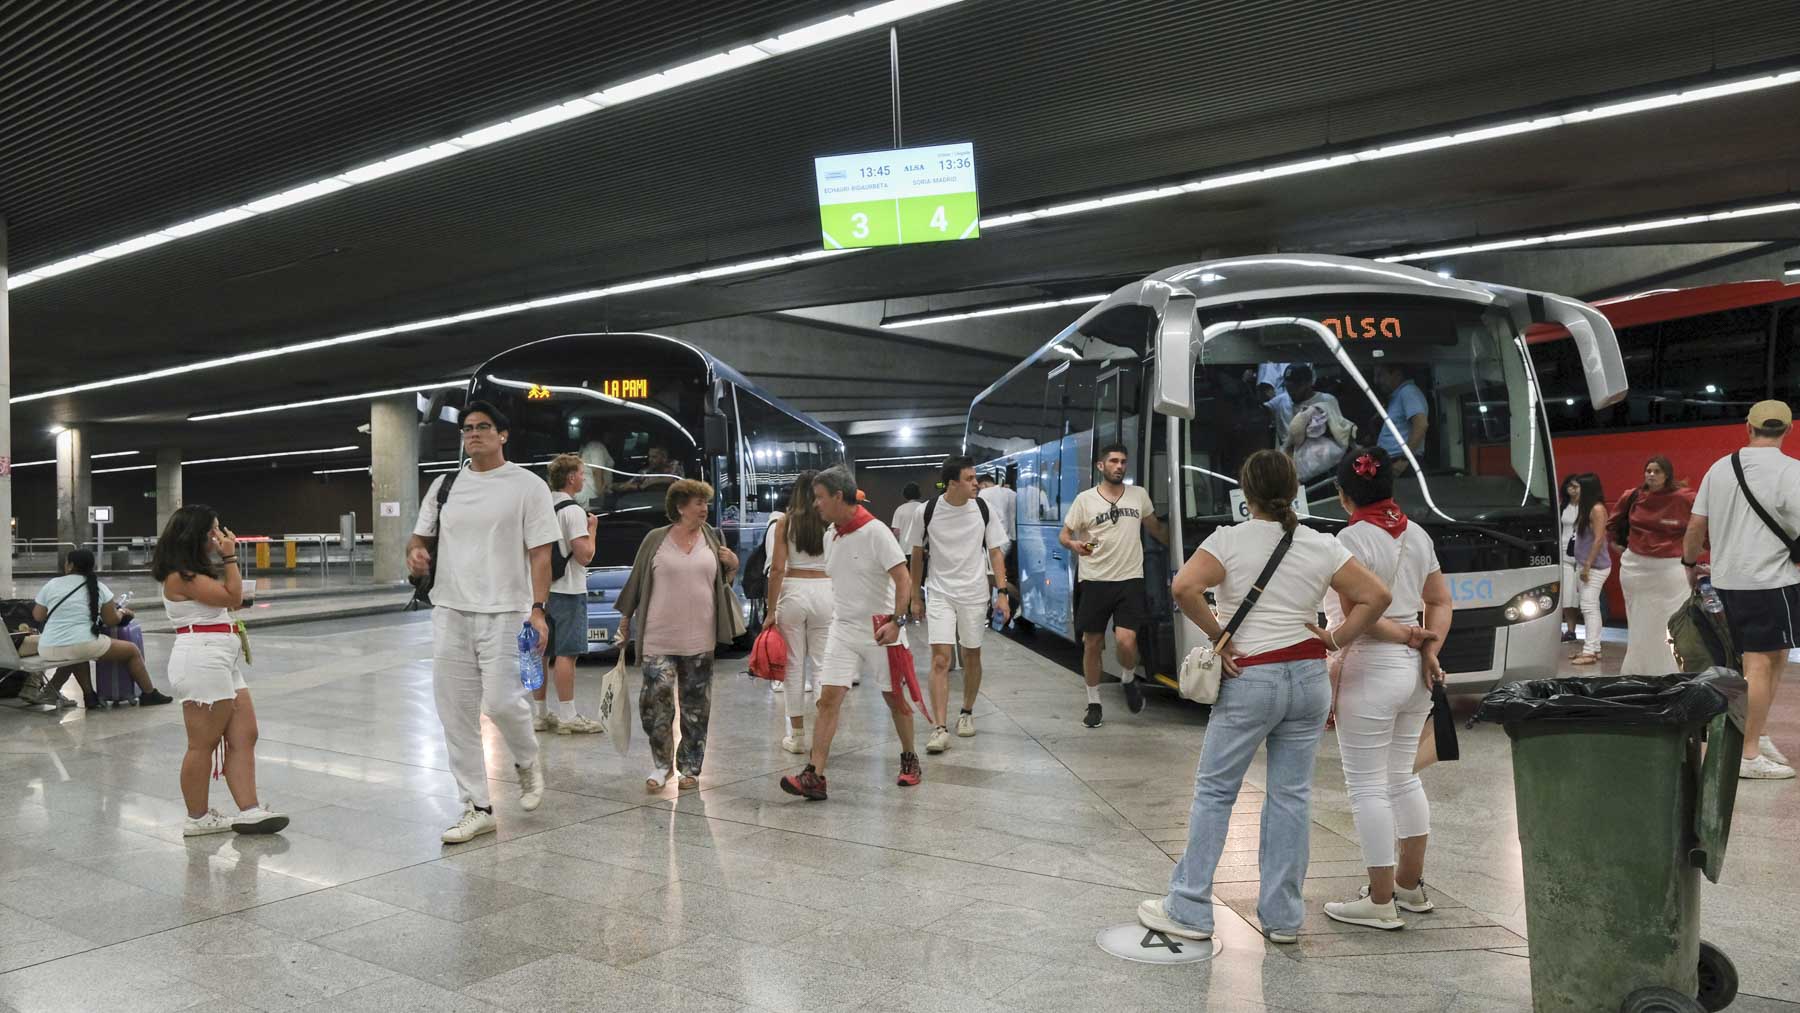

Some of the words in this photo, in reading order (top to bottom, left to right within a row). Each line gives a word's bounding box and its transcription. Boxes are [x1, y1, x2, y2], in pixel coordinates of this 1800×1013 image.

[903, 164, 925, 172] ALSA
[938, 157, 971, 171] 13:36
[859, 165, 891, 178] 13:45
[851, 212, 870, 239] 3
[929, 205, 949, 232] 4
[604, 380, 619, 398] LA
[1529, 555, 1552, 566] 3680
[588, 629, 607, 639] JHW
[1140, 929, 1184, 954] 4
